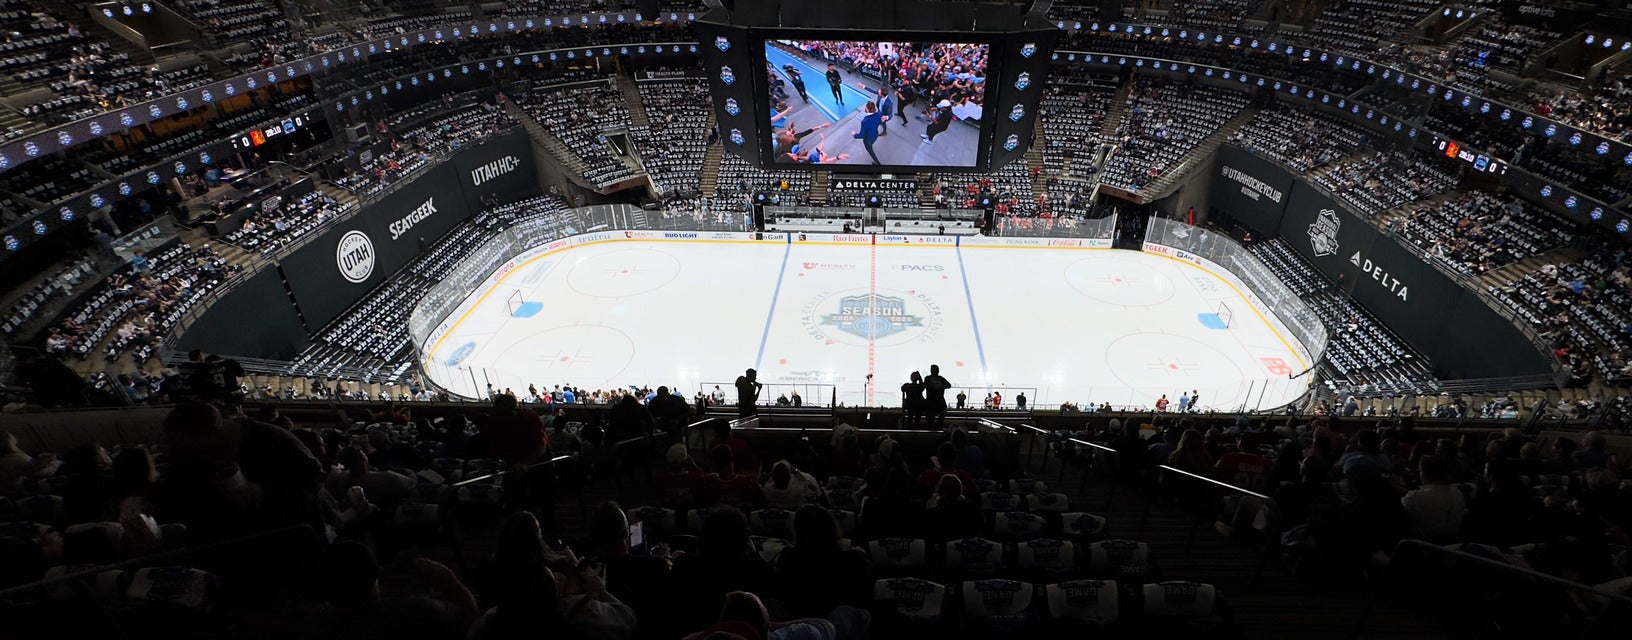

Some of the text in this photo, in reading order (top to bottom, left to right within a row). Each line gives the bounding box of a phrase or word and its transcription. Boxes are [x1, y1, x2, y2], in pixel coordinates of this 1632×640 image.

[471, 155, 521, 186] UTAH HC+
[1222, 165, 1282, 203] @UTAHHOCKEYCLUB
[846, 181, 915, 189] DELTA CENTER
[388, 197, 438, 241] SEATGEEK
[343, 236, 362, 252] HOCKEY
[343, 243, 370, 271] UTAH
[355, 265, 369, 277] CLUB
[1362, 258, 1409, 302] DELTA
[843, 307, 902, 316] SEASON
